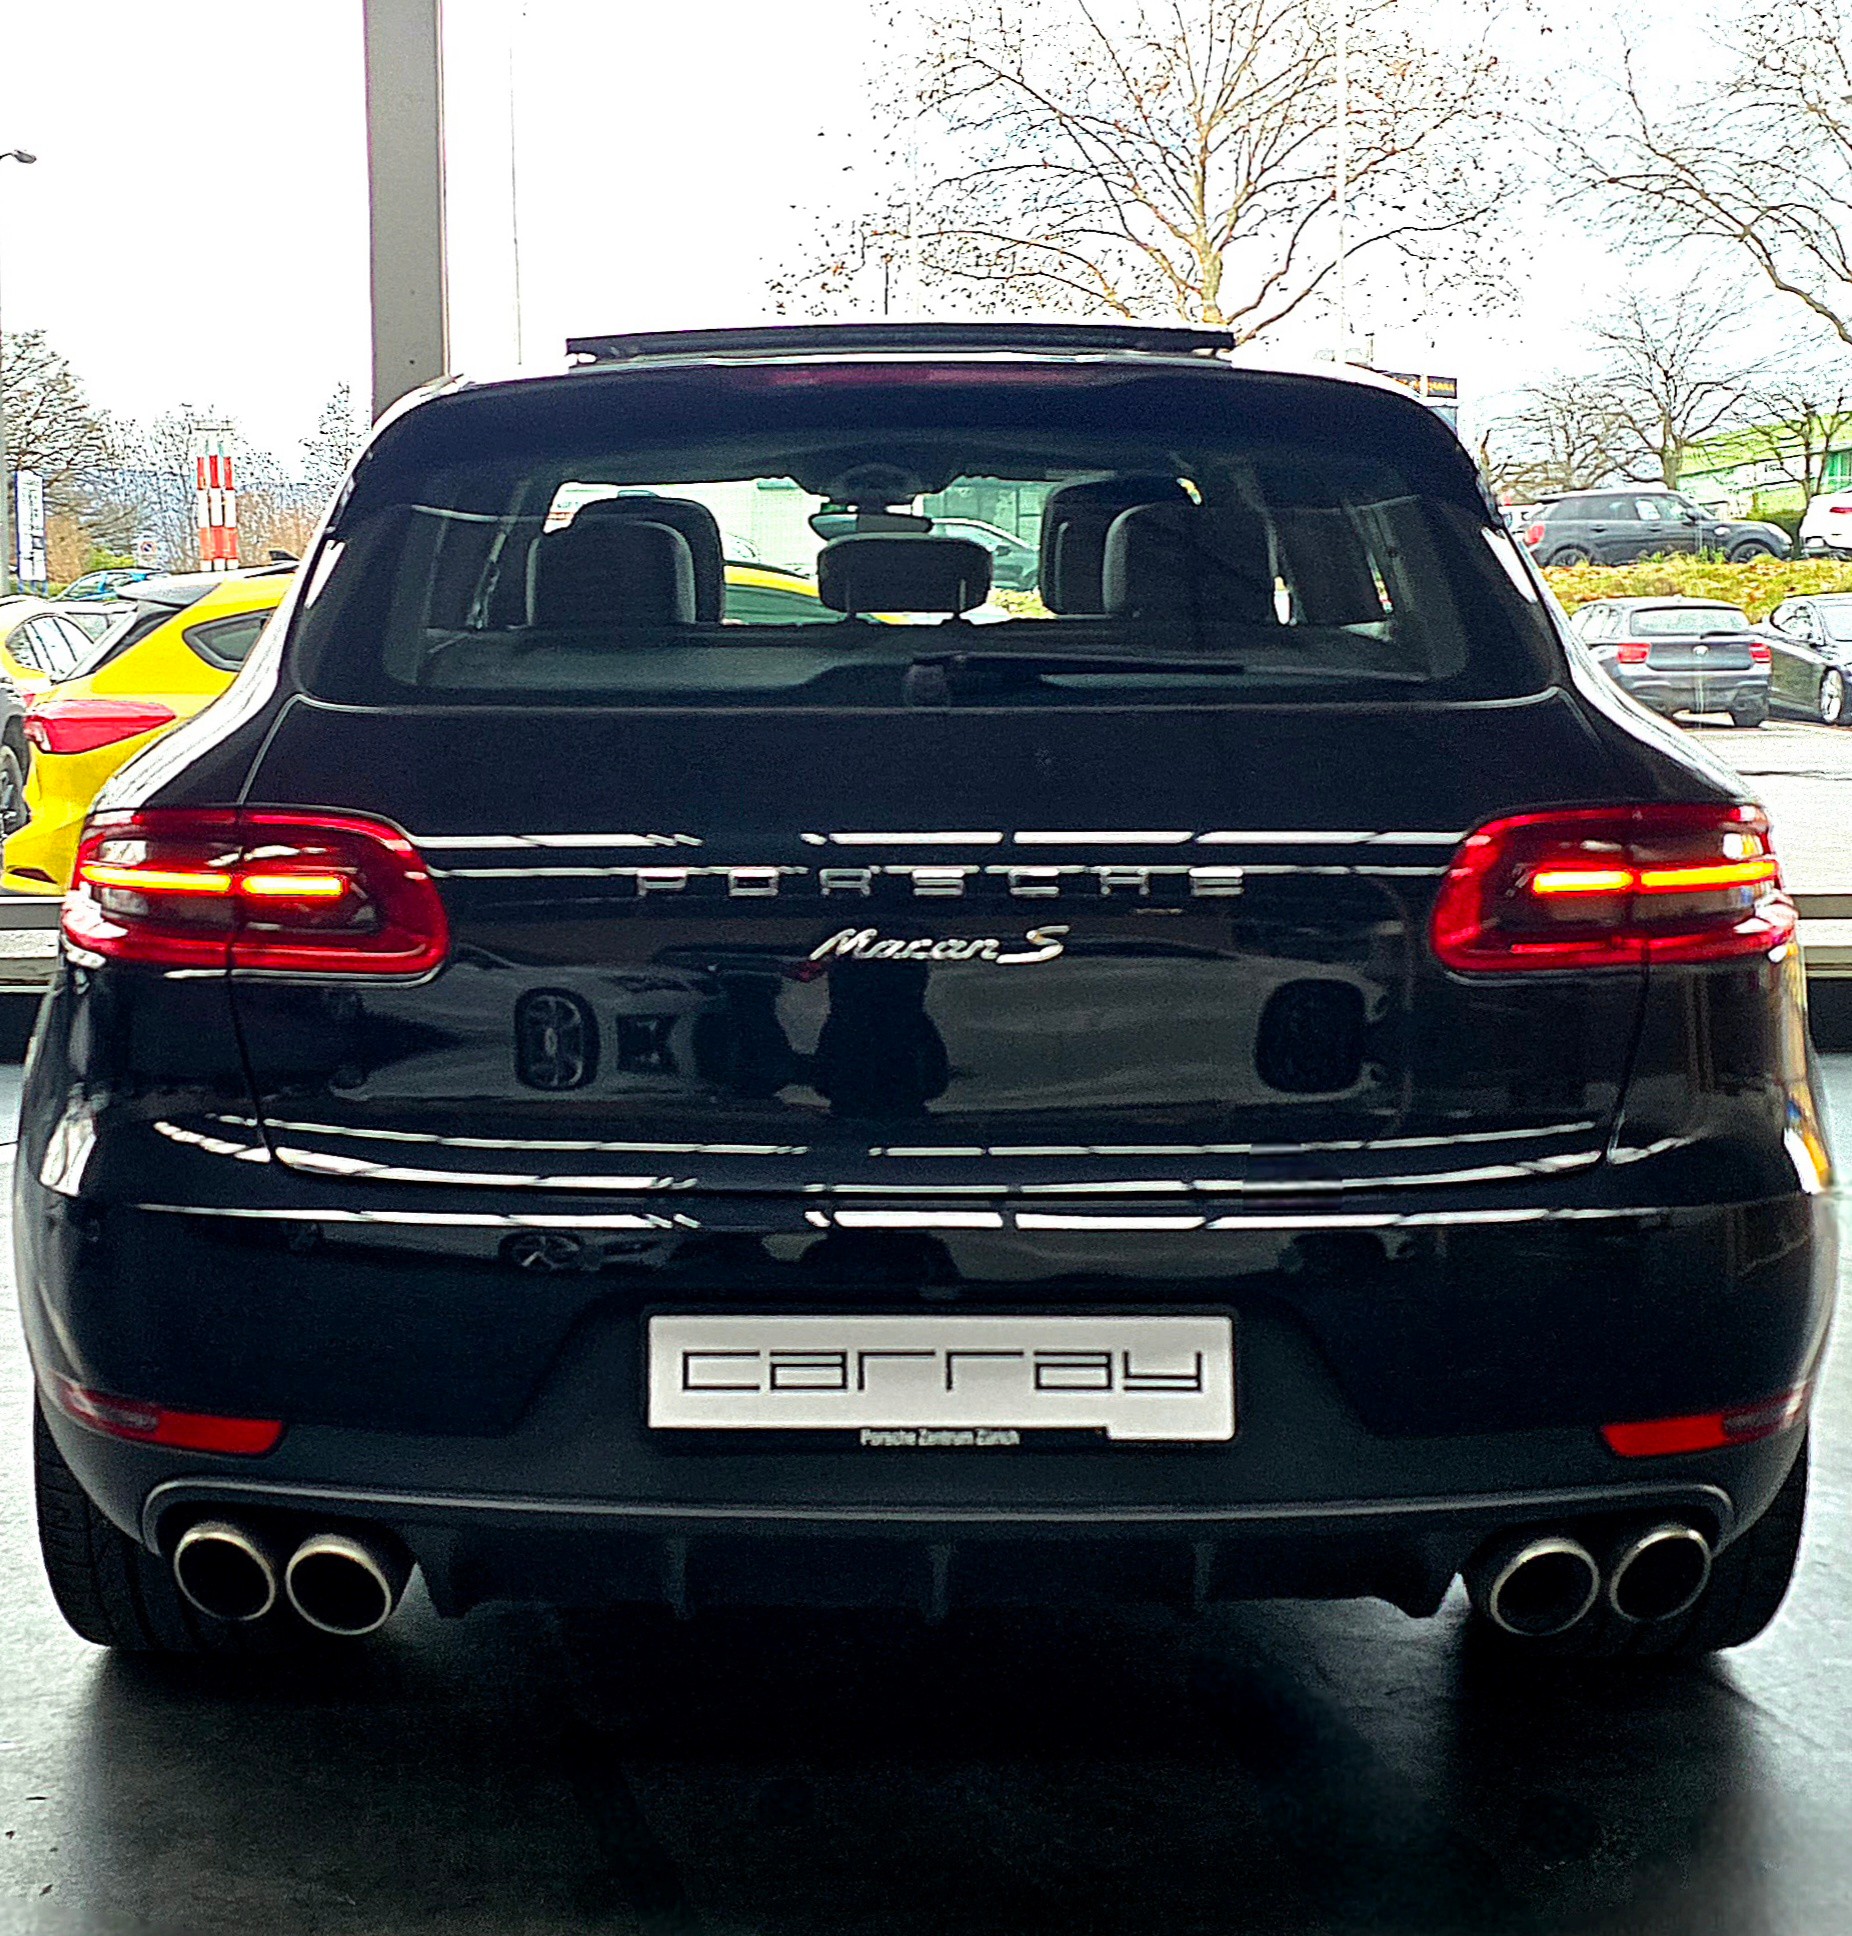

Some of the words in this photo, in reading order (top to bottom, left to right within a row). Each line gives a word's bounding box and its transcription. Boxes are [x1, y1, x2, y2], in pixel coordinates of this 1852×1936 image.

[636, 866, 1245, 897] PORSCHE
[809, 927, 1001, 961] Macan
[996, 925, 1071, 963] S
[682, 1350, 1202, 1391] carray
